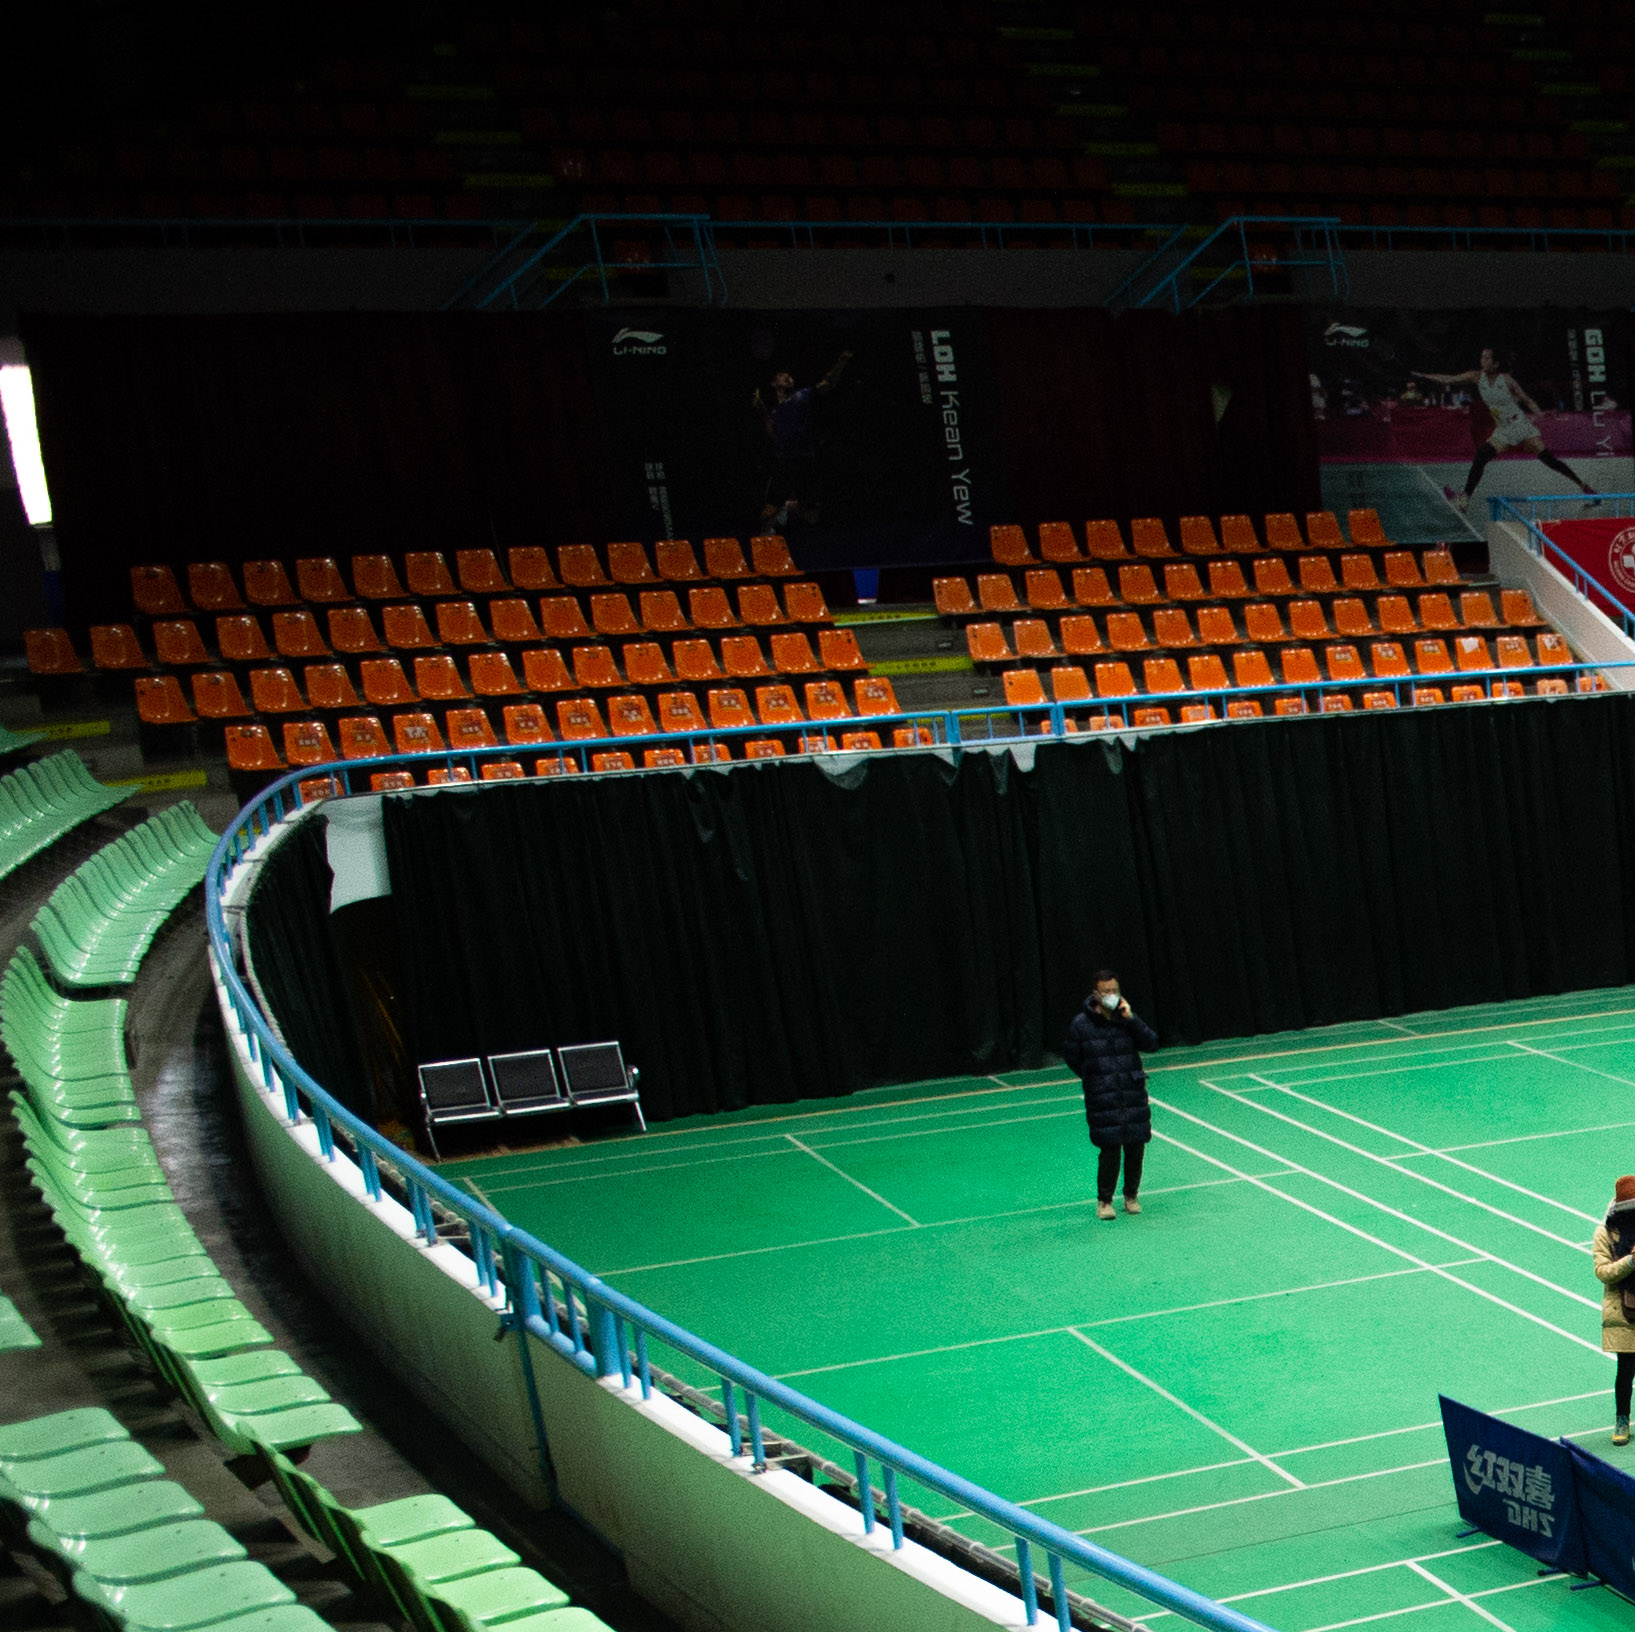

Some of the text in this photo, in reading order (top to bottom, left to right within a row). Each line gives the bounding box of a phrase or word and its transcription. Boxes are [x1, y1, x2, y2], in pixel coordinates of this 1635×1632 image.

[1584, 327, 1607, 383] GOH
[930, 328, 974, 527] LOH Kean Yew
[1462, 1443, 1556, 1511] 红双喜
[1502, 1498, 1556, 1539] DHS
